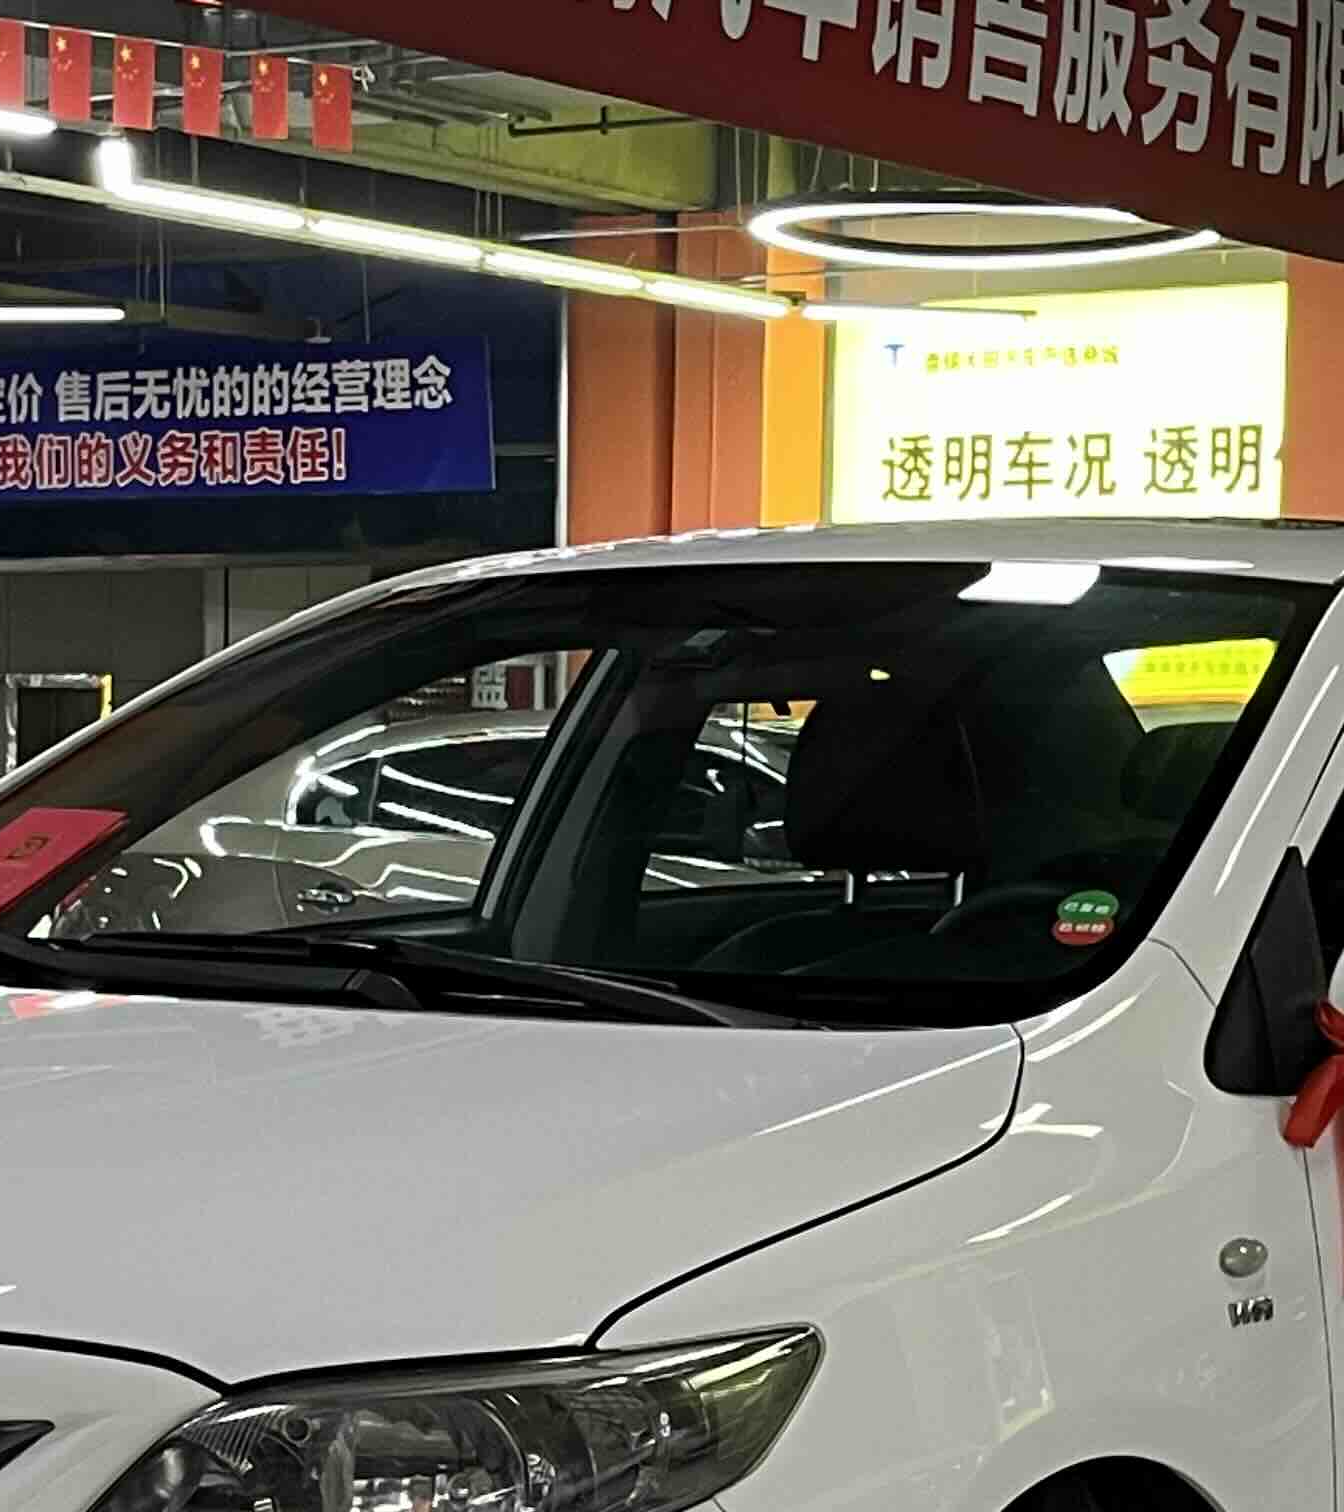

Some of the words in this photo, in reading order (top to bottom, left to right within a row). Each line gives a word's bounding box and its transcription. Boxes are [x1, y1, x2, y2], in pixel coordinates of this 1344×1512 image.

[54, 354, 454, 425] 售后无忧的的经营理念
[881, 433, 1117, 501] 透明车况
[1143, 423, 1283, 495] 透明
